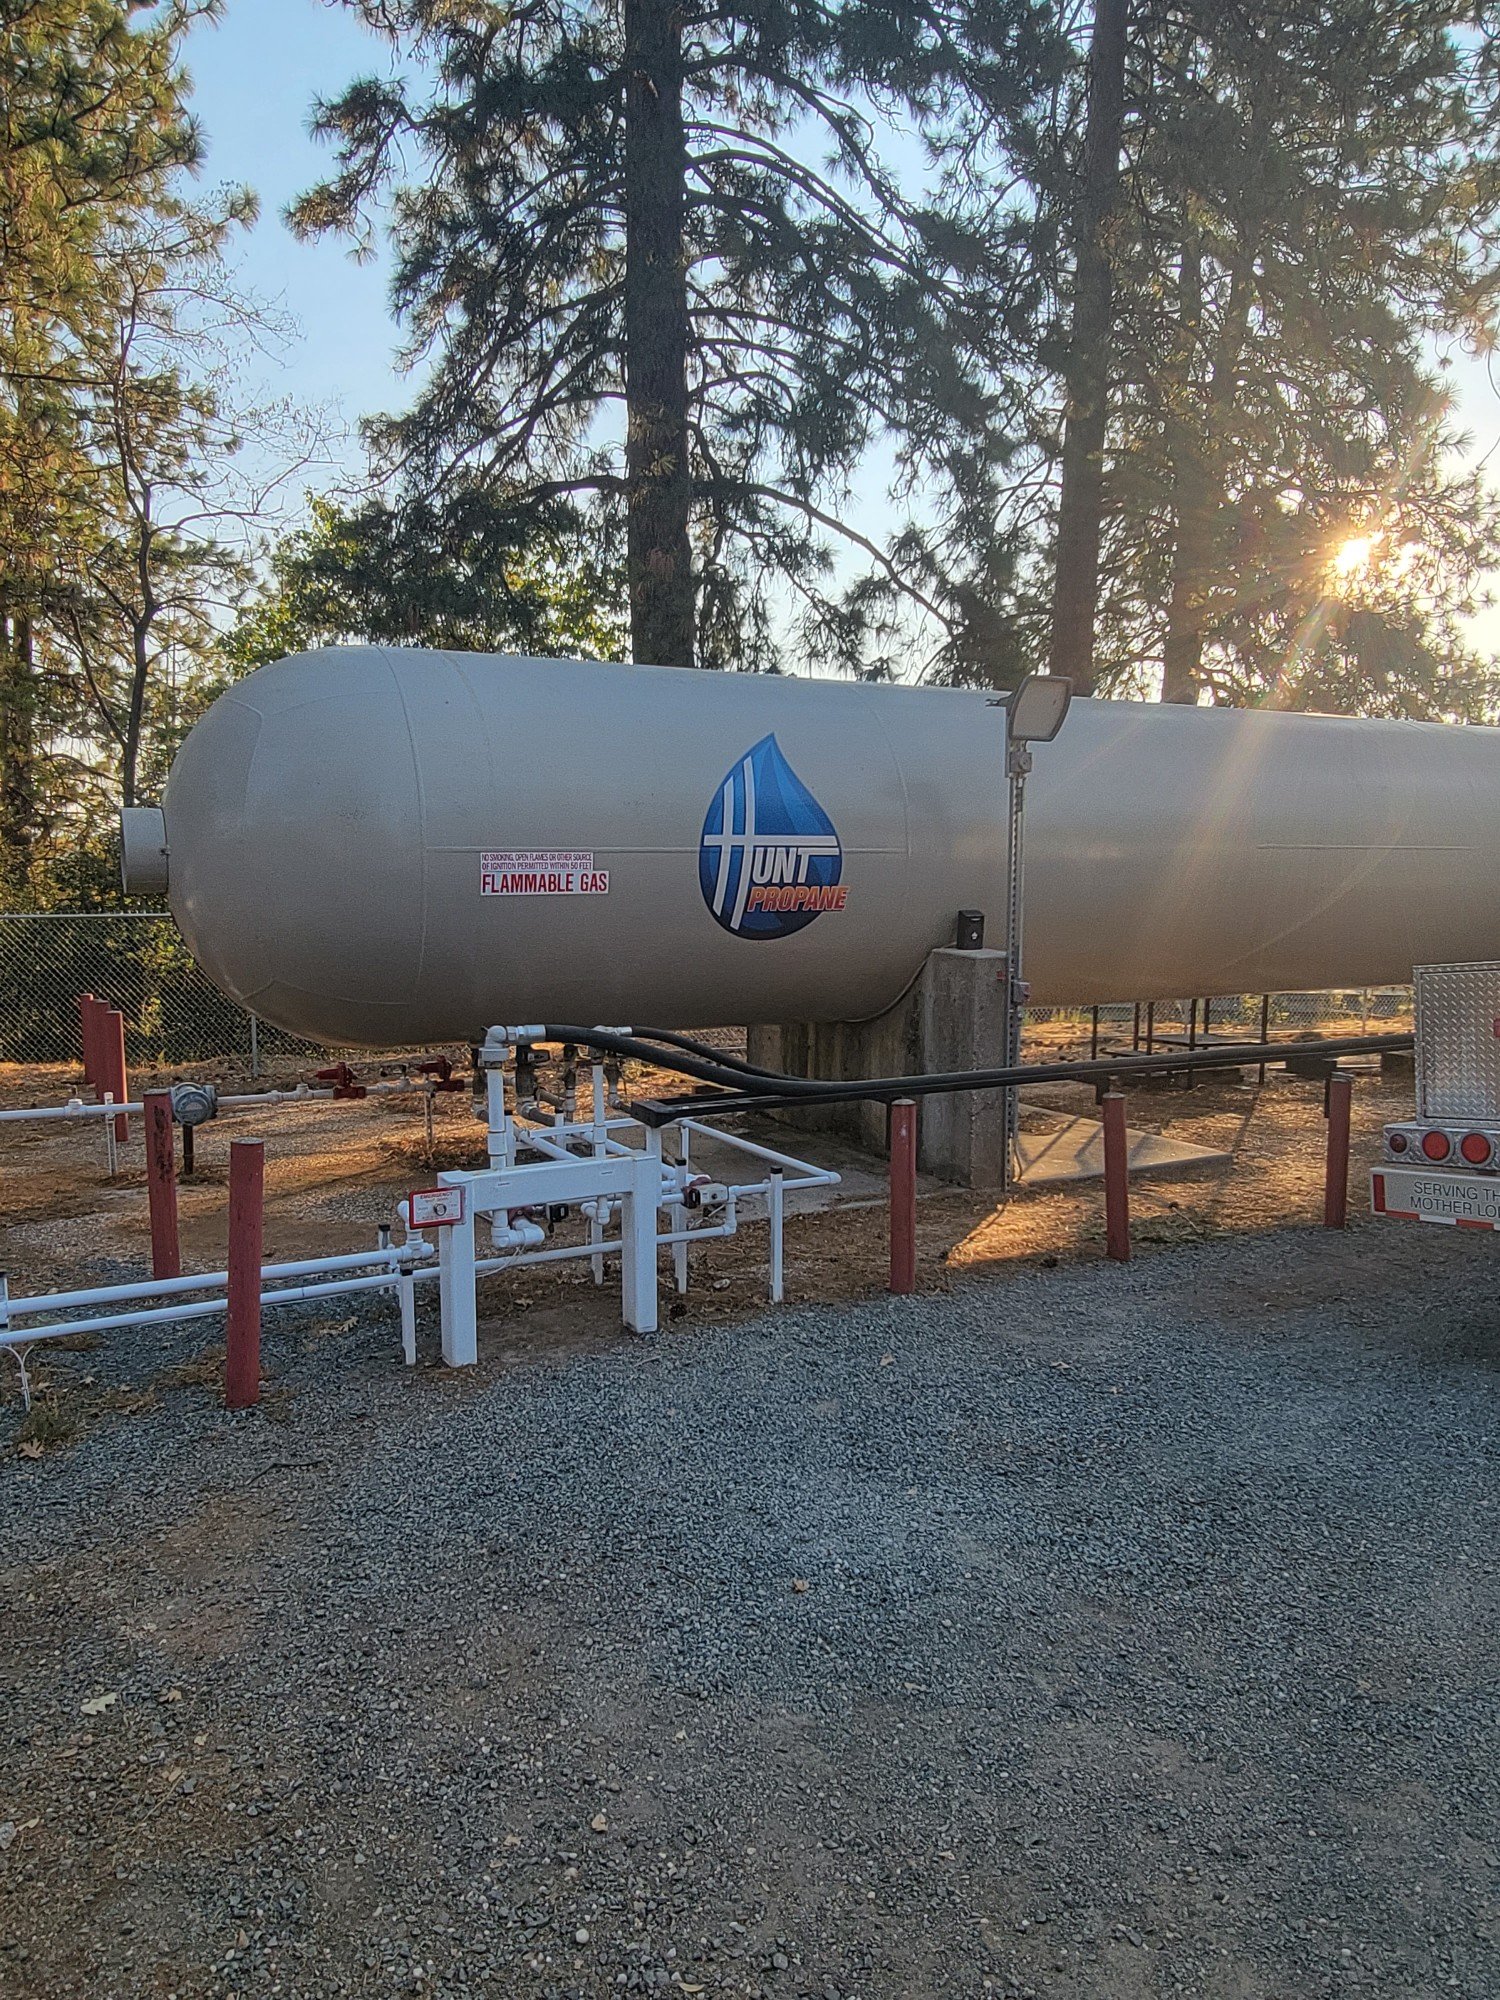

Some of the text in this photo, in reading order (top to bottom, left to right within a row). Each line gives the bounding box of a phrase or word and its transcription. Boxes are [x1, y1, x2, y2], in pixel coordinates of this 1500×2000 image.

[482, 853, 489, 861] NO
[515, 853, 529, 861] OPEN
[530, 853, 548, 861] FLAMES
[549, 853, 556, 861] OR
[557, 853, 572, 861] OTHER
[573, 853, 592, 861] SOURCE
[482, 862, 592, 870] OF IGNITION PERMITTED WITHIN 50 FEET
[482, 872, 607, 893] FLAMMABLE GAS
[747, 885, 849, 912] PROPANE
[1414, 1181, 1478, 1200] SERVING
[1410, 1196, 1500, 1218] MOTHER LO
